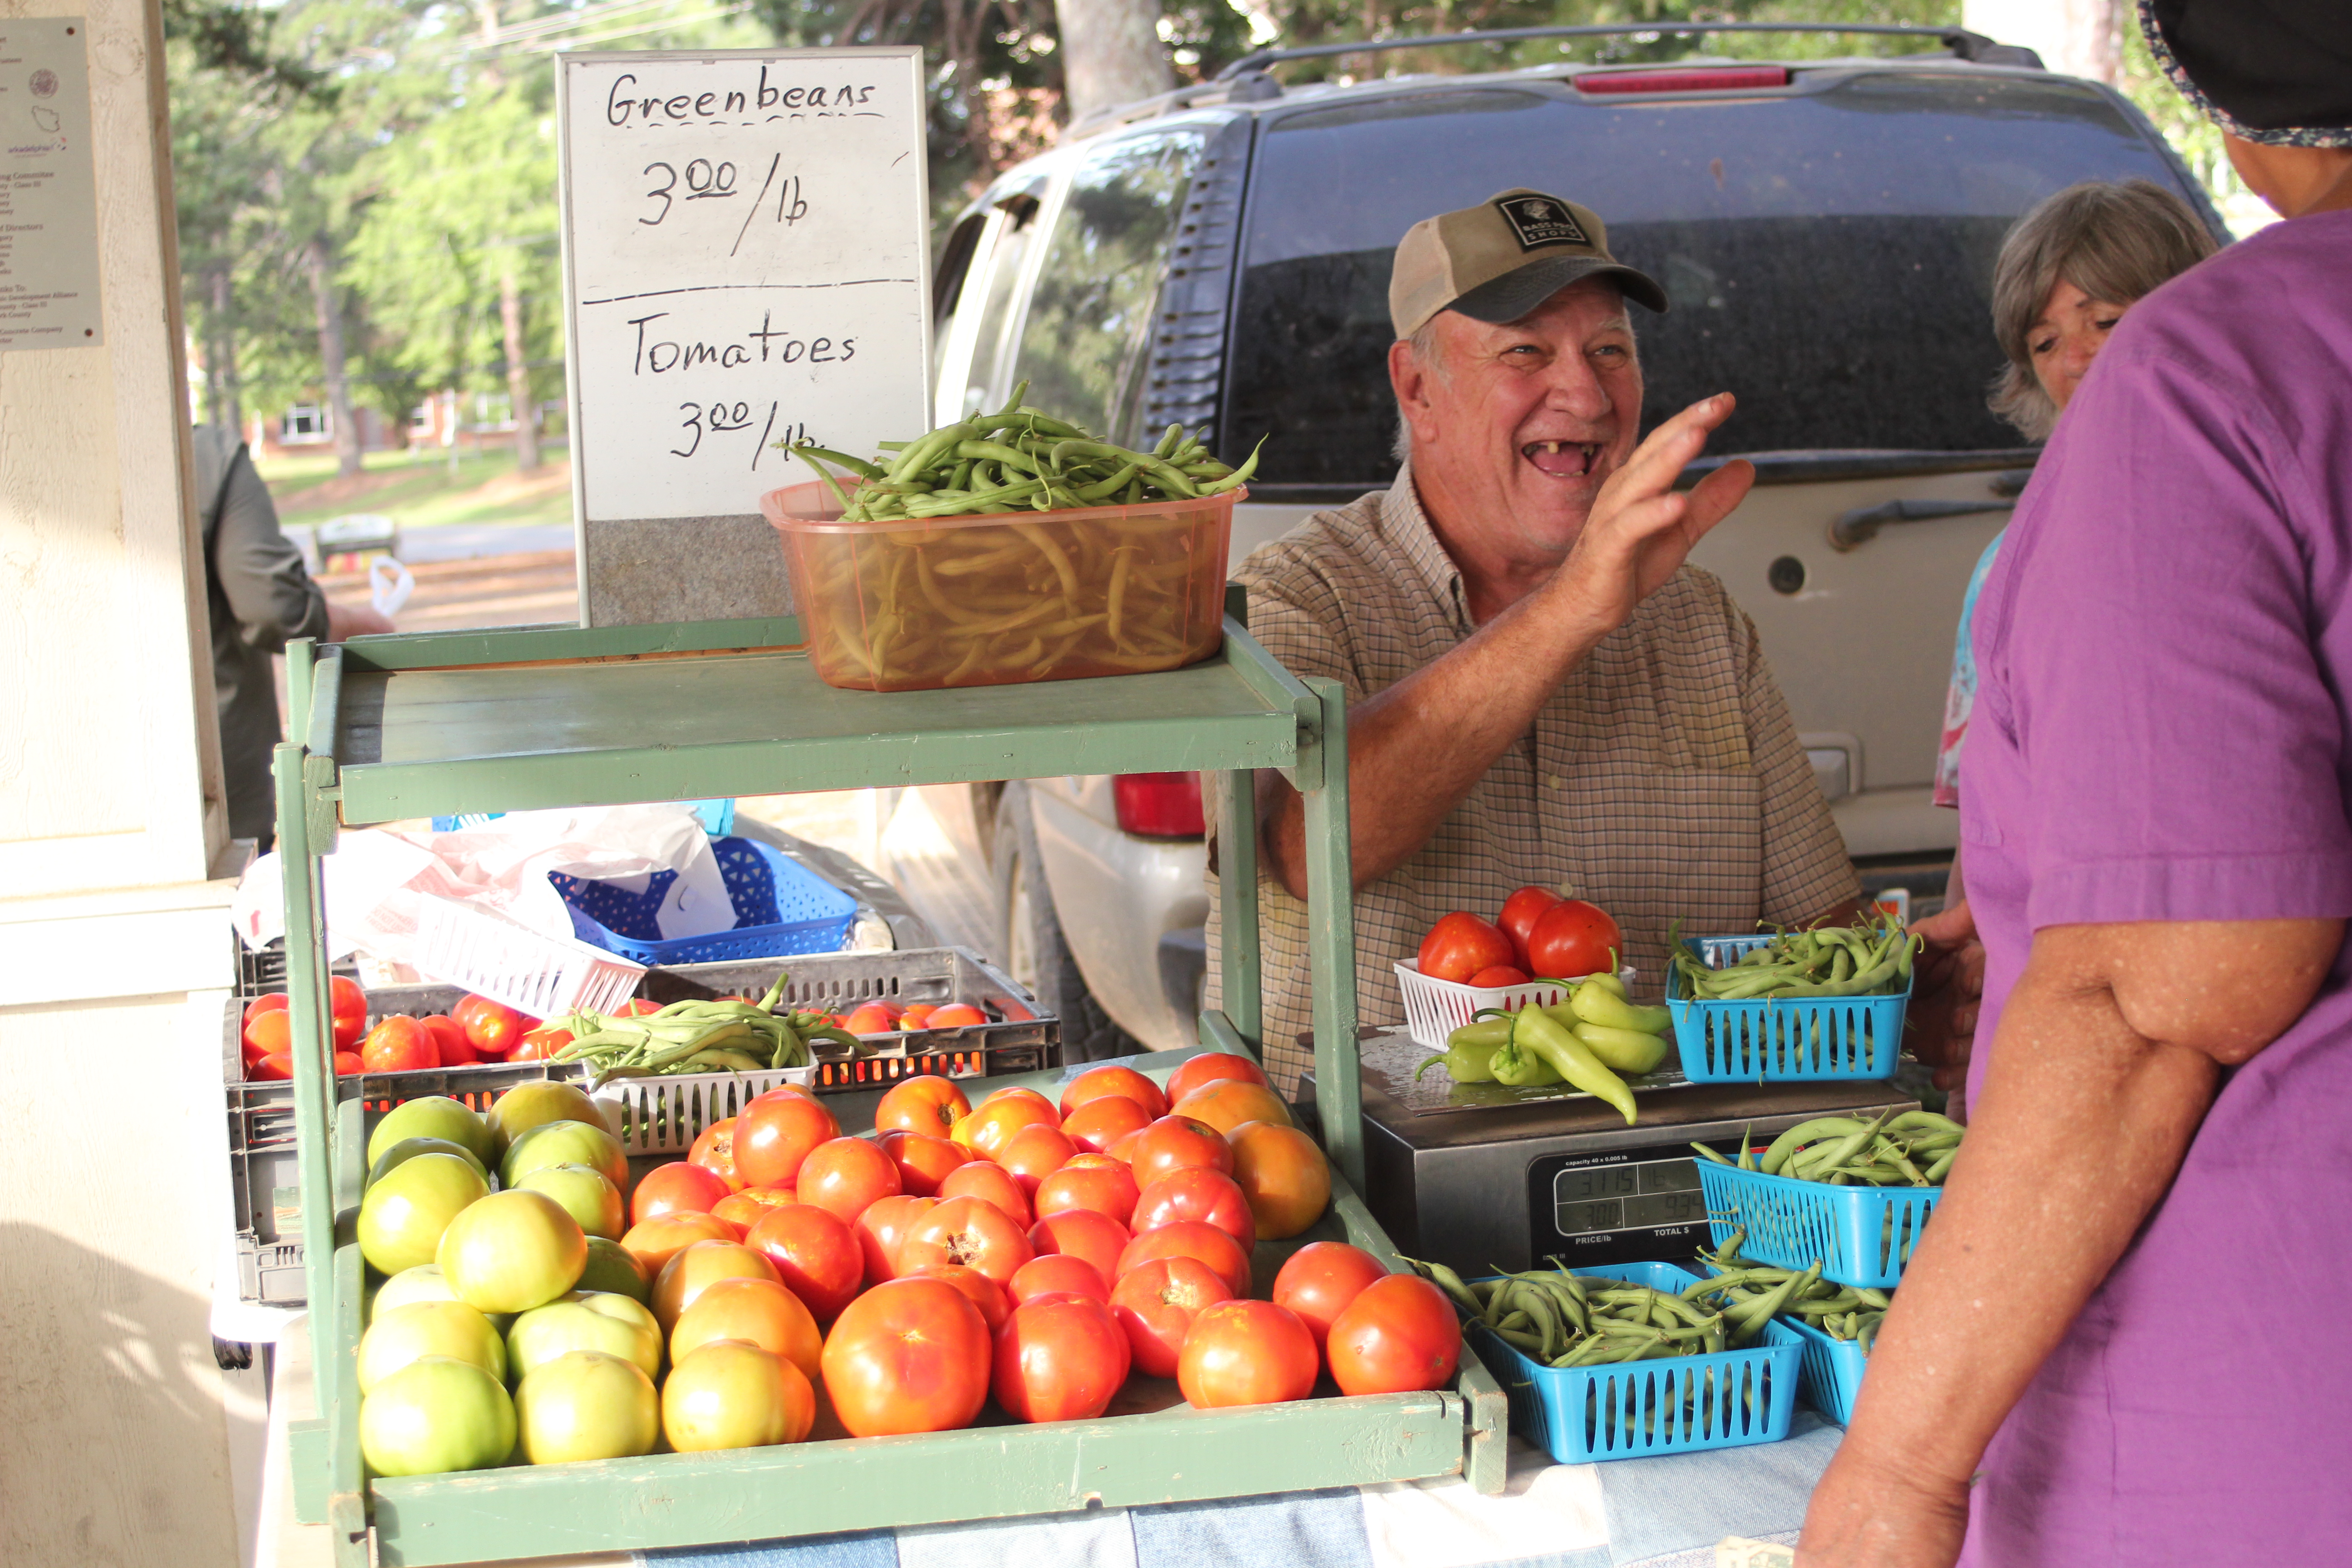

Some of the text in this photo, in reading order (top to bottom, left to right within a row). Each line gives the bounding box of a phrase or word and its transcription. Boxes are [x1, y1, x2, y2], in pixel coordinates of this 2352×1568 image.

[607, 66, 877, 126] Greenbeans
[5, 224, 44, 232] Directors
[627, 309, 858, 375] Tomatoes
[1654, 1227, 1681, 1236] TOTAL
[1575, 1235, 1611, 1245] PRICE/lb
